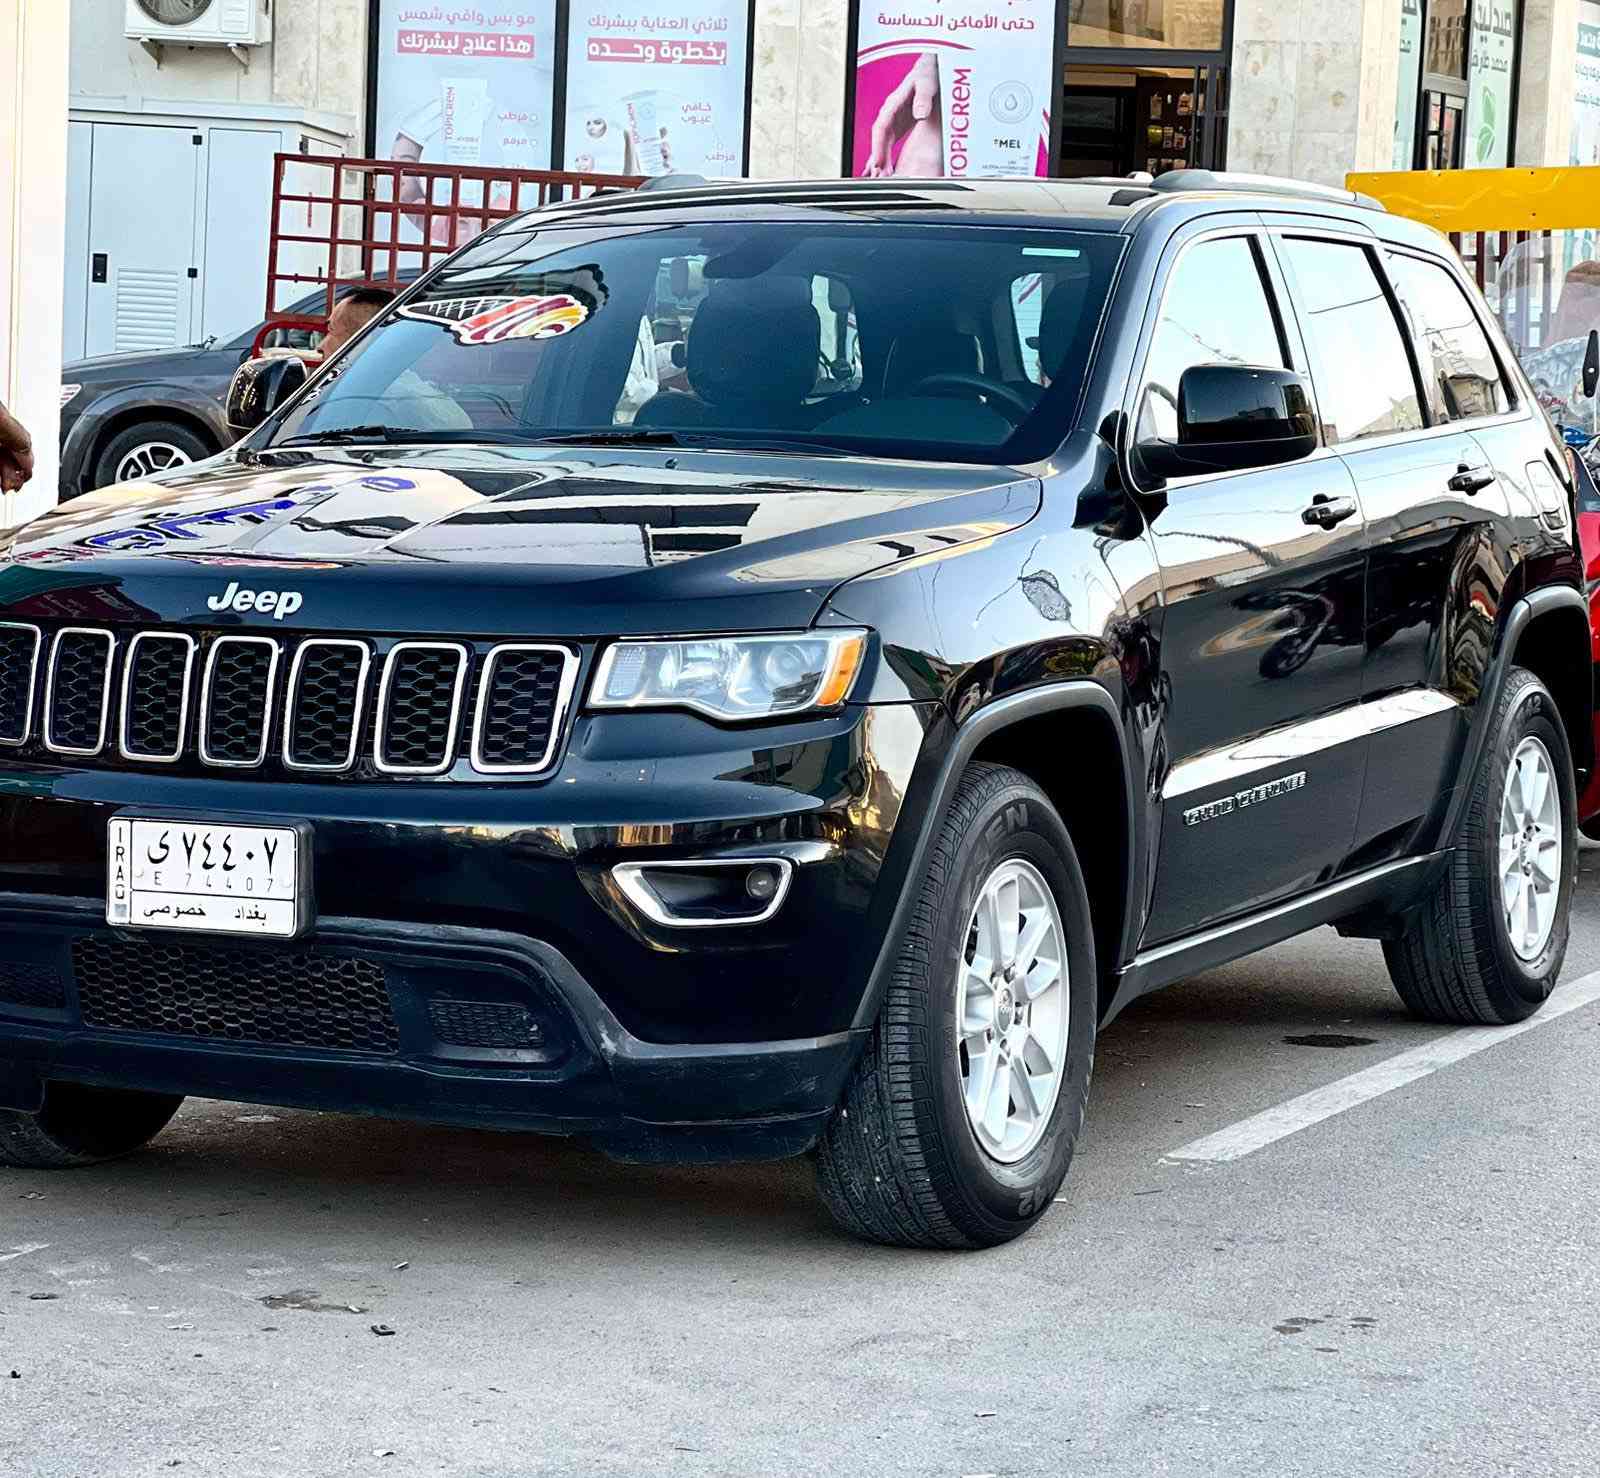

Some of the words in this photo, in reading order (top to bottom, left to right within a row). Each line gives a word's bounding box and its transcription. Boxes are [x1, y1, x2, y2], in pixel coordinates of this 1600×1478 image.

[398, 5, 442, 22] شمس
[516, 14, 535, 27] مو
[878, 12, 943, 28] الحساسة
[947, 13, 998, 31] الأماكن
[588, 14, 637, 32] ببشرتك
[641, 15, 688, 32] العناية
[1002, 16, 1034, 31] حتى
[400, 32, 459, 53] لبشرتك
[463, 35, 496, 55] علاج
[500, 36, 531, 53] هذا
[660, 41, 726, 65] بخطوة
[206, 581, 304, 622] Jeep
[234, 904, 268, 926] بغداد
